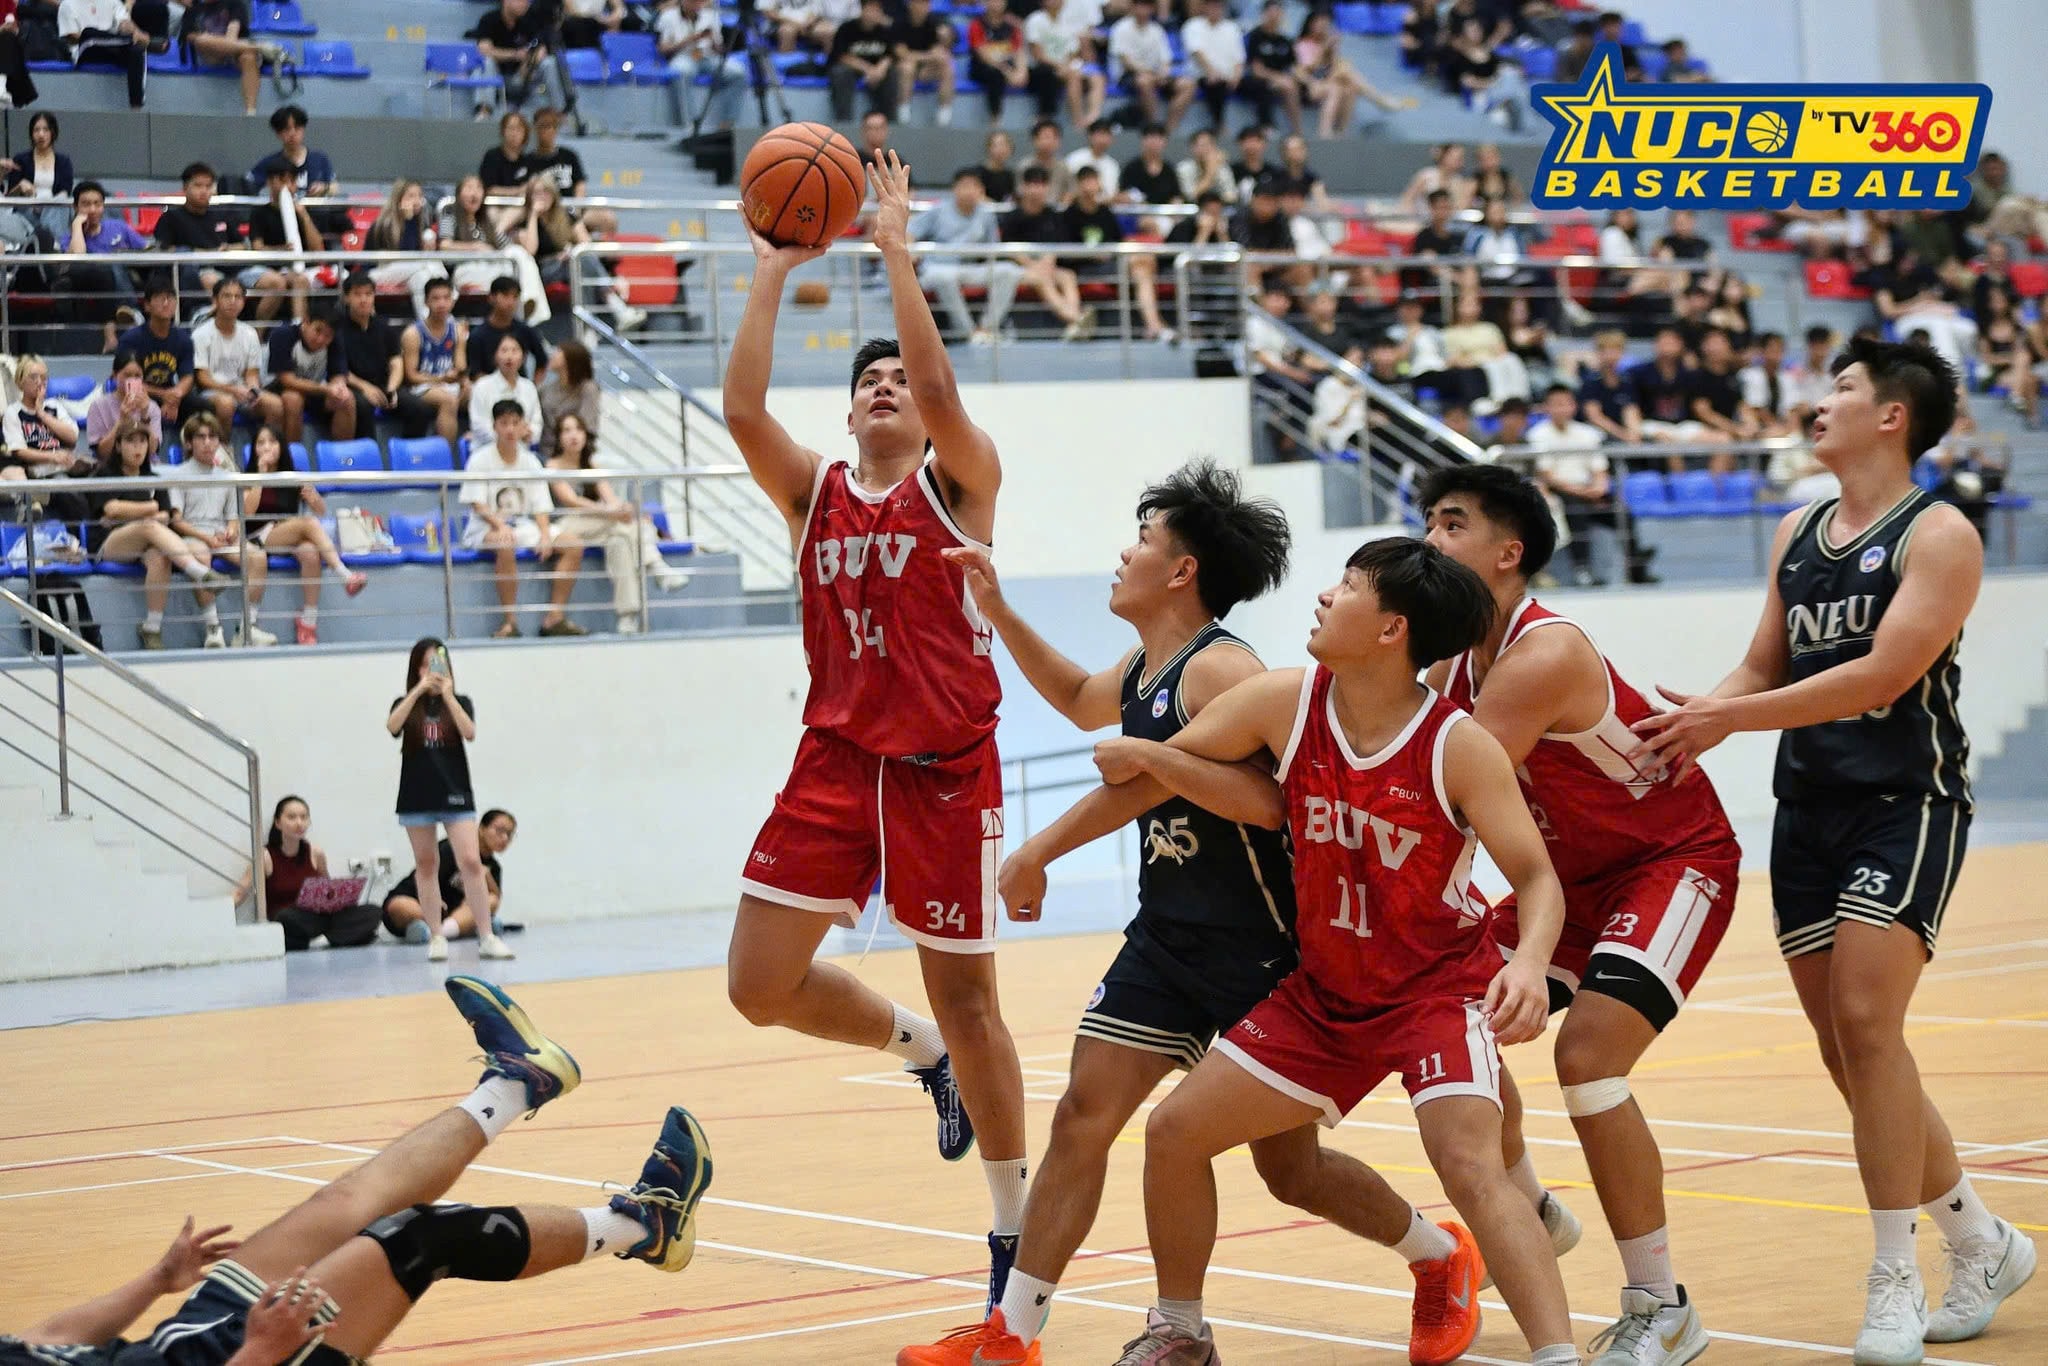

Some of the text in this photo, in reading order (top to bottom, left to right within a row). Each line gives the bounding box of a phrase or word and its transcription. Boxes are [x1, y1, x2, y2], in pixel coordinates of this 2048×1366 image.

[815, 532, 917, 585] BUV
[844, 608, 887, 660] 34
[1787, 595, 1877, 647] NEU
[1399, 788, 1421, 801] BUV
[1305, 795, 1422, 871] BUV
[757, 852, 777, 865] BUV
[1847, 867, 1892, 895] 23
[925, 901, 966, 932] 34
[1330, 875, 1372, 938] 11
[1601, 913, 1639, 937] 23
[1244, 1021, 1268, 1039] BUV
[1418, 1052, 1446, 1083] 11
